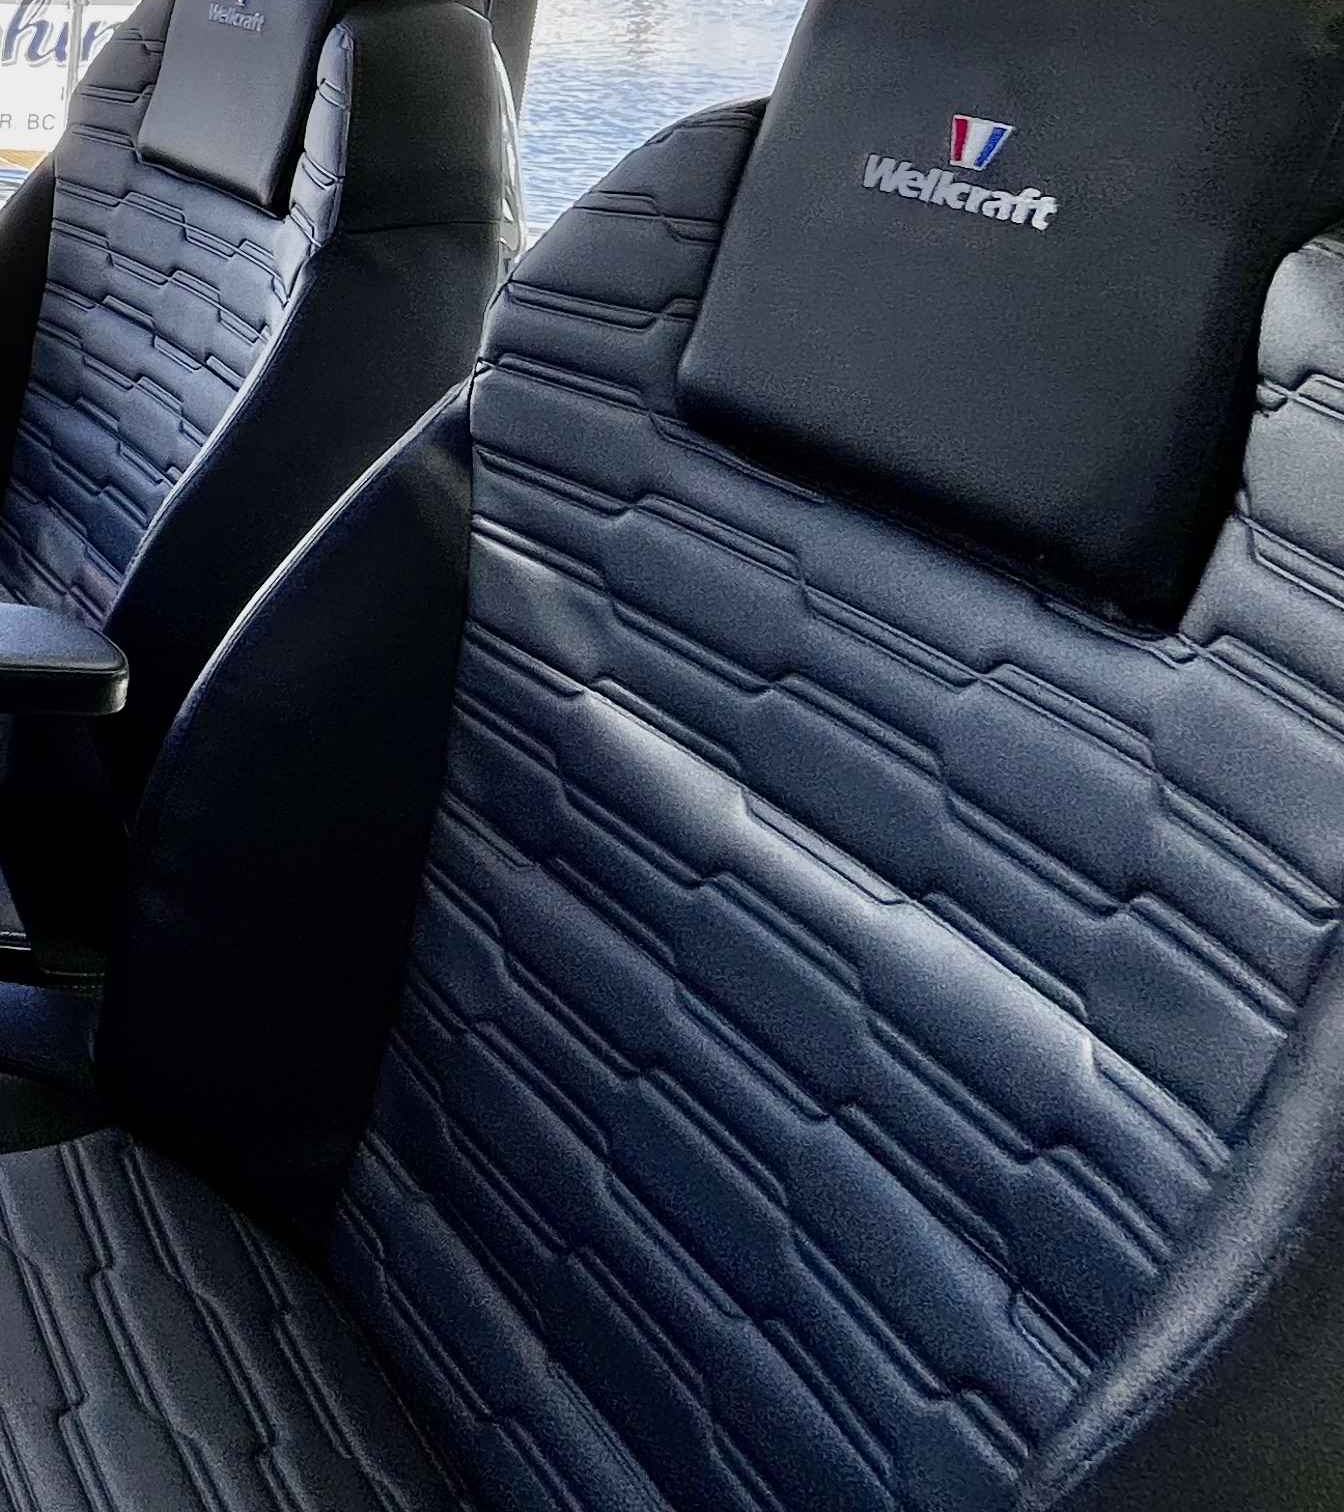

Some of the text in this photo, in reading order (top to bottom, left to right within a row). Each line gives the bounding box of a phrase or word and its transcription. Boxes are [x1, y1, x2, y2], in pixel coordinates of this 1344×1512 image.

[208, 2, 265, 32] Wellcraft
[26, 112, 56, 131] BC
[862, 153, 1058, 231] Wellcraft
